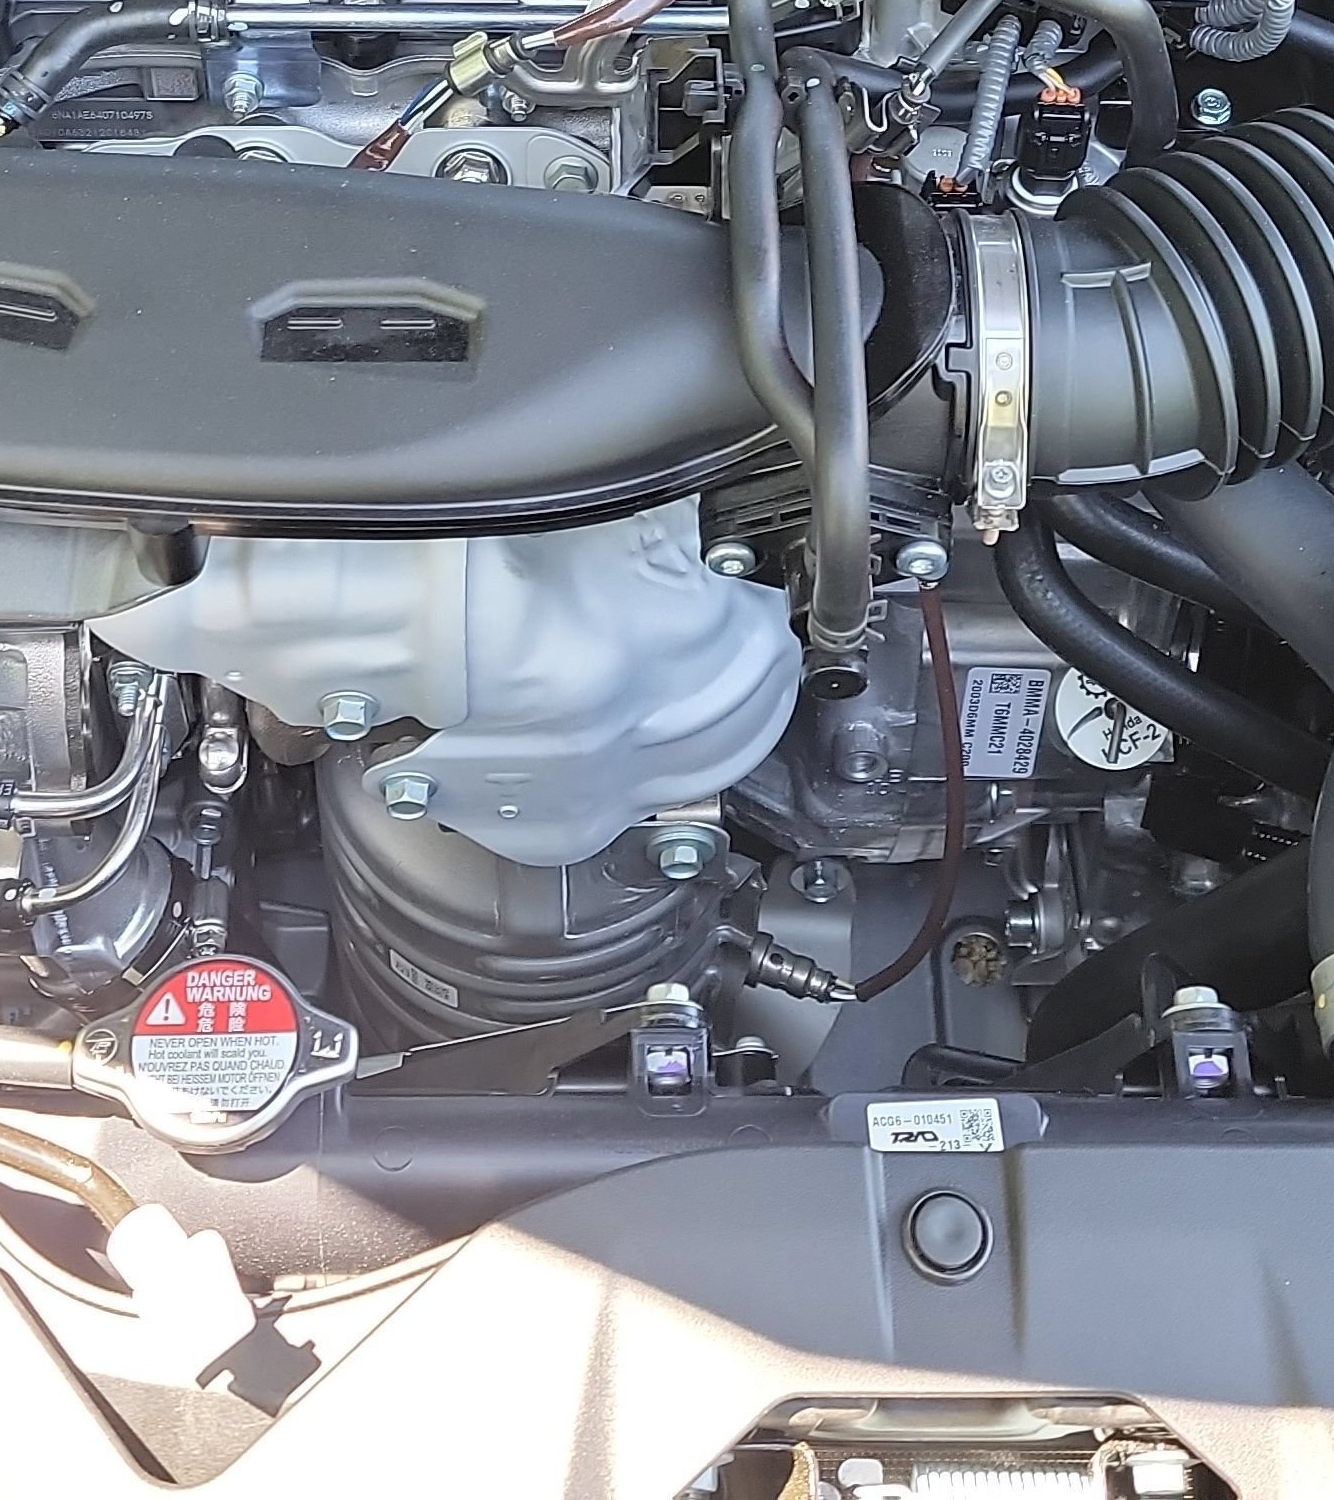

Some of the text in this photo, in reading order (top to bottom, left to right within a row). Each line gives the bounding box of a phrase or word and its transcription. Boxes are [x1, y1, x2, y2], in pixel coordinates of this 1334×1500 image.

[964, 679, 984, 738] 2003D6MM
[987, 701, 1012, 755] T6MMC21
[1011, 680, 1045, 774] BMMA-4028429
[186, 970, 257, 987] DANGER
[185, 984, 272, 1003] WARNUNG
[149, 1036, 279, 1048] NEVER OPEN WHEN HOT.
[148, 1048, 267, 1061] Hot coolant will scald you.
[190, 1061, 210, 1071] PAS
[212, 1060, 248, 1071] QUAND
[166, 1074, 180, 1084] BEI
[180, 1073, 216, 1084] HEISSEM
[217, 1073, 247, 1083] MOTOR
[872, 1114, 953, 1127] ACG6-010451
